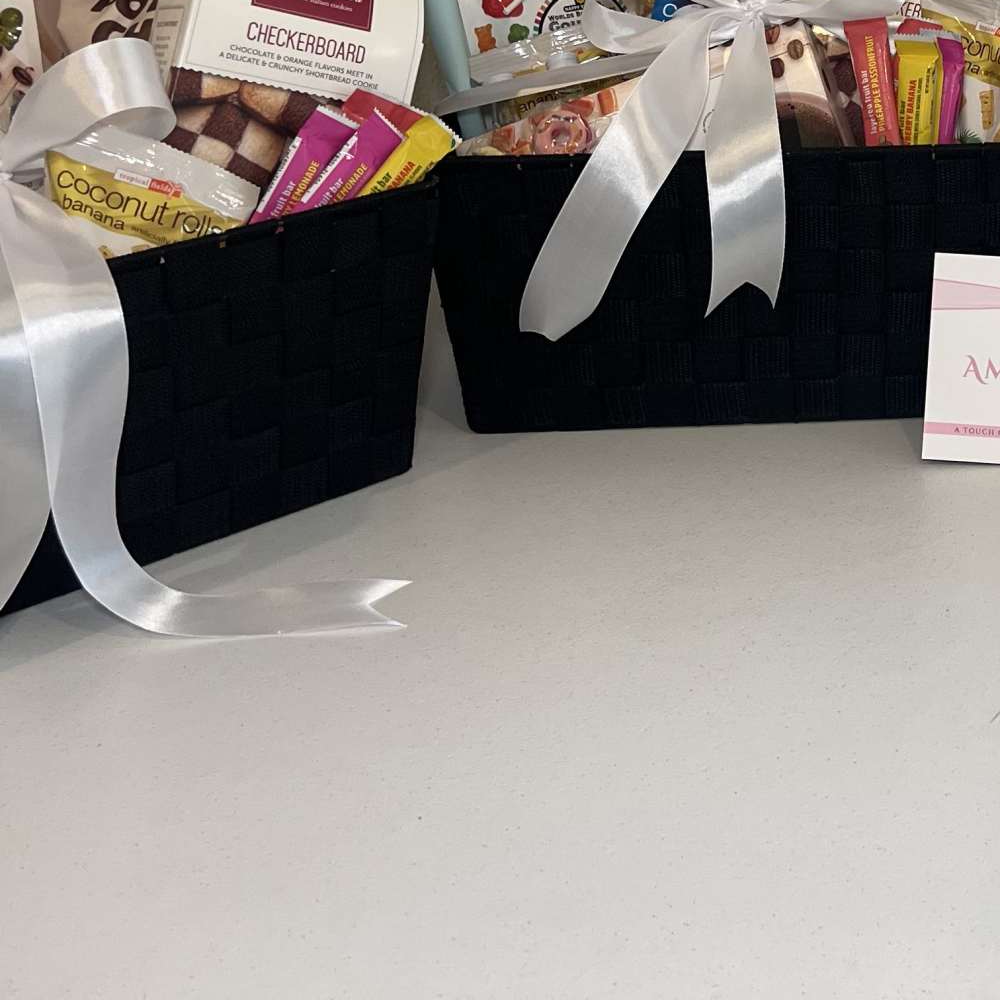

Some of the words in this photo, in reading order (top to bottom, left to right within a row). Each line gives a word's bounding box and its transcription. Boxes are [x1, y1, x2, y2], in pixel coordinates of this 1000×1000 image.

[230, 44, 278, 61] CHOCOLATE
[283, 56, 313, 68] ORANGE
[315, 61, 345, 74] FLAVORS
[346, 68, 365, 79] MEET
[247, 21, 366, 65] CHECKERBOARD
[865, 35, 880, 88] PASSIONFRUIT
[226, 53, 260, 67] DELICATE
[268, 61, 304, 75] CRUNCHY
[305, 69, 352, 85] SHORTBREAD
[352, 78, 379, 91] COOKIE
[906, 79, 917, 114] BANANA
[57, 169, 170, 226] coconut
[283, 180, 296, 195] bar
[293, 160, 321, 204] LEMONADE
[330, 177, 345, 194] bar
[333, 162, 369, 206] LEMONADE
[63, 194, 125, 231] banana
[963, 426, 995, 436] TOUCH
